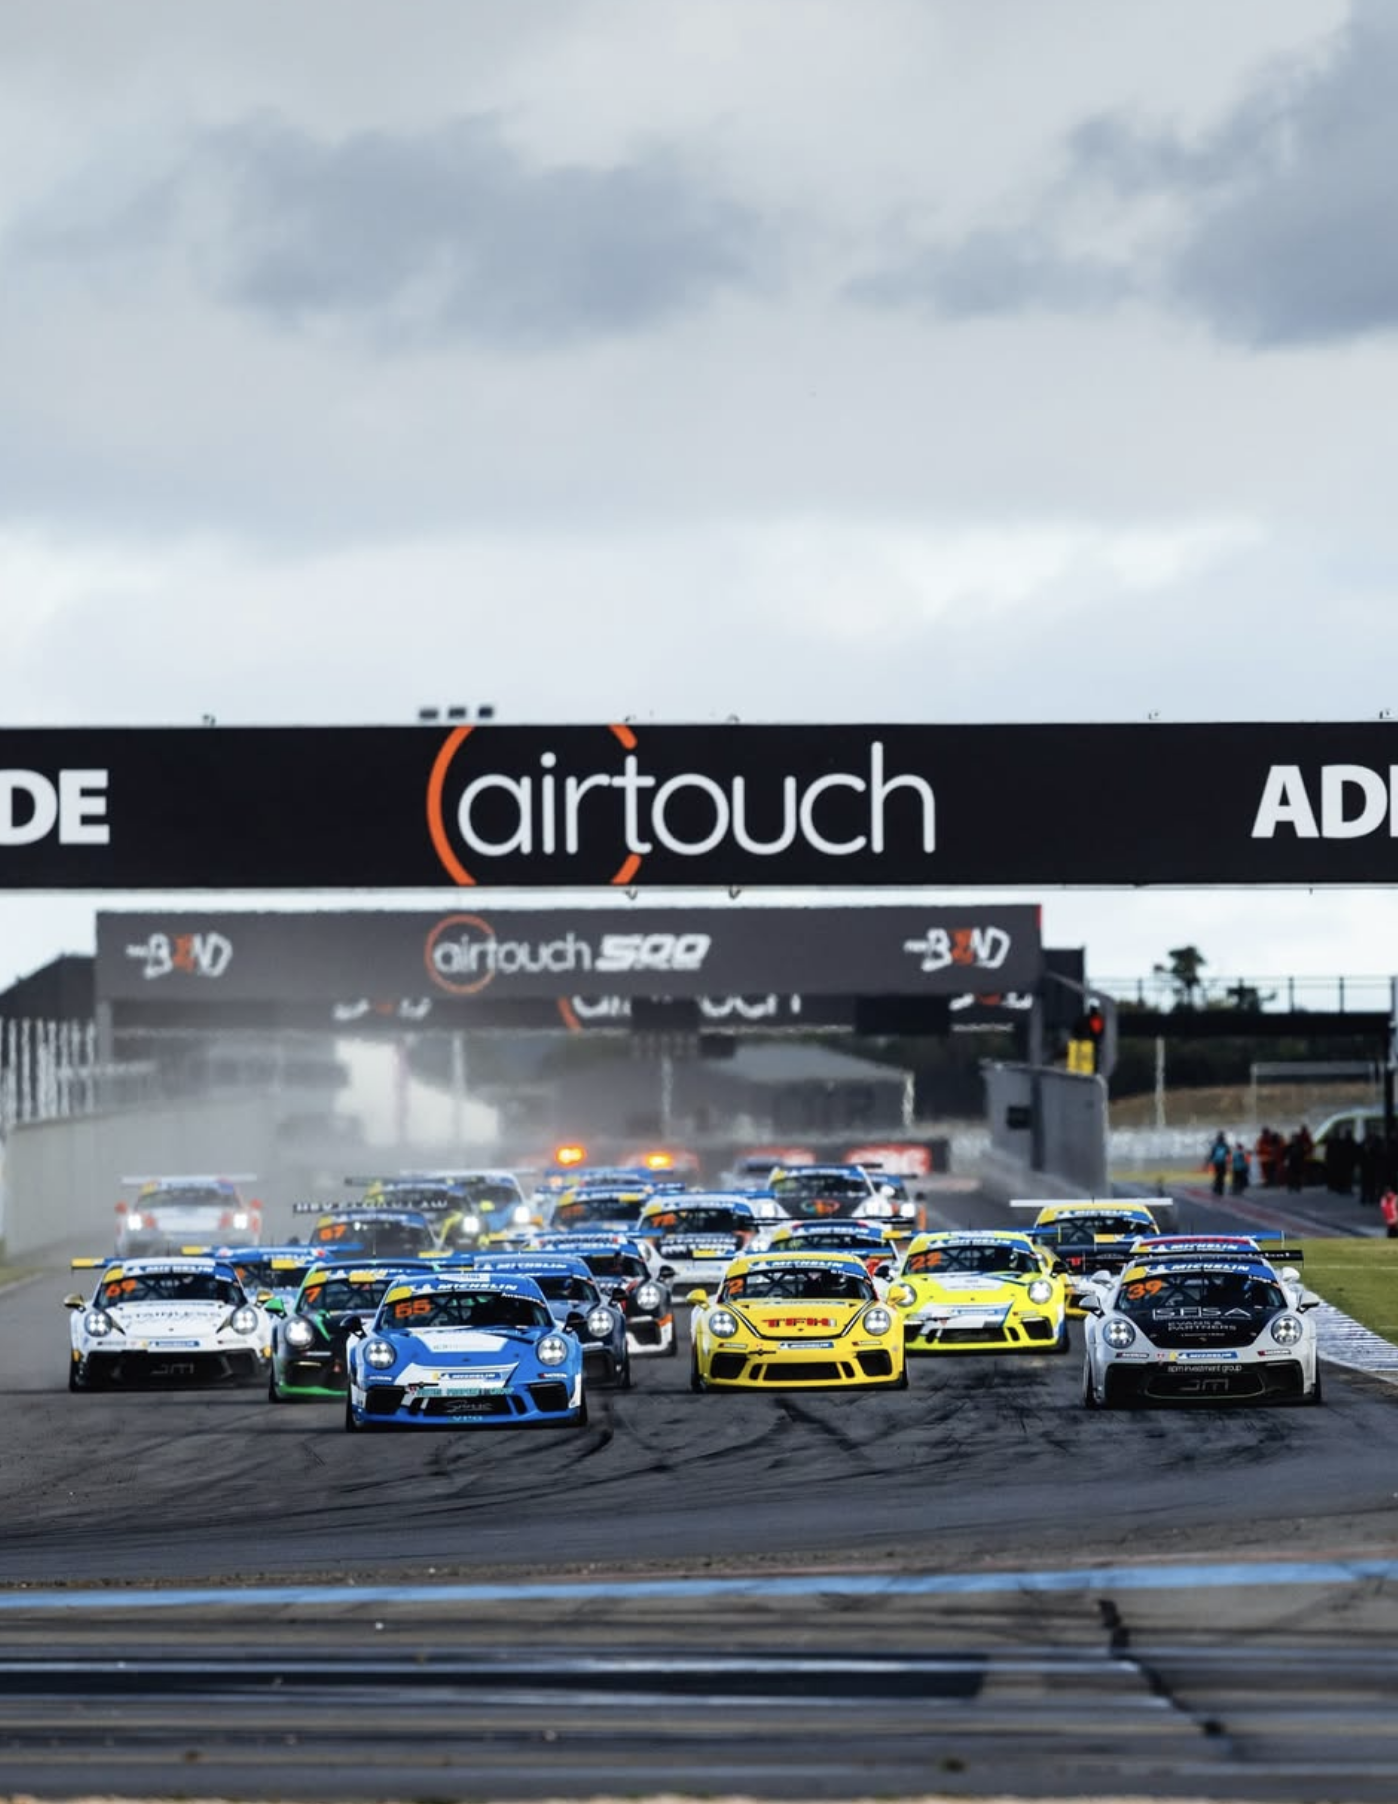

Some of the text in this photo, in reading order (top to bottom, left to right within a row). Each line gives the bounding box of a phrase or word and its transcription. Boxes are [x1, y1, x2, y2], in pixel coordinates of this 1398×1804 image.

[457, 741, 936, 856] airtouch
[1251, 765, 1398, 839] AD
[433, 932, 592, 973] airtouch
[1170, 1243, 1239, 1251] MICHELIN
[496, 1262, 567, 1270] MICHELIN
[910, 1251, 942, 1270] 22
[1171, 1263, 1250, 1272] MICHELIN
[305, 1286, 323, 1303] 7
[437, 1283, 518, 1292] MICHELIN
[1126, 1278, 1163, 1300] 39
